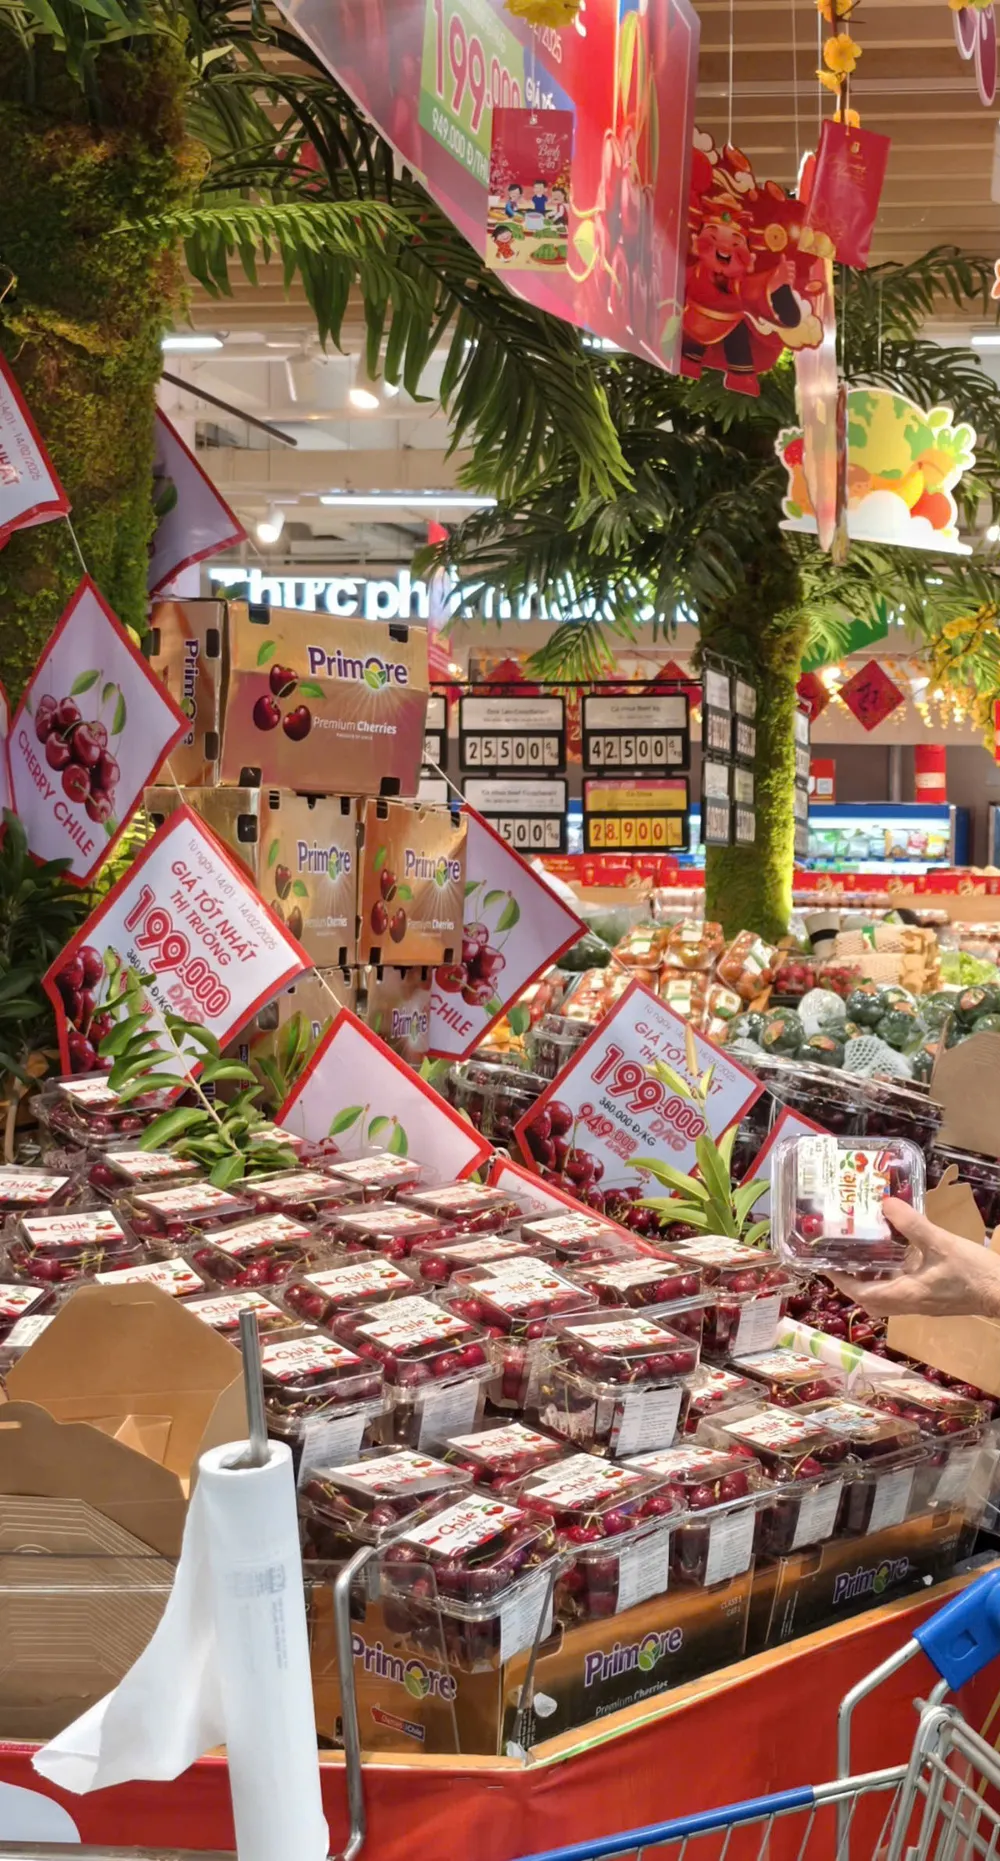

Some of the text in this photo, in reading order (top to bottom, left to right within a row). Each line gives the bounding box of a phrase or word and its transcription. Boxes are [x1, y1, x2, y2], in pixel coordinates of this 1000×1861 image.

[313, 716, 398, 735] Premium Cherries
[468, 739, 541, 760] 25.500
[592, 739, 664, 760] 42.500
[18, 730, 57, 802] CHERRY
[54, 801, 96, 858] CHILE
[502, 822, 542, 841] 500
[592, 823, 663, 840] 28.900
[171, 860, 257, 965] GIÁ TỐT NHẤT
[194, 852, 215, 877] ngày
[214, 872, 236, 899] 14/01
[238, 902, 277, 952] 14/02/2025
[170, 889, 232, 967] THỊ TRƯỜNG
[123, 883, 231, 1018] 199.000
[430, 994, 474, 1038] CHILE
[634, 1021, 687, 1070] GIÁ TỐT
[591, 1043, 707, 1142] 199.000
[576, 1101, 639, 1155] 949.000
[599, 1096, 657, 1147] 380.000 Đ/KG
[648, 1119, 688, 1152] Đ/KG
[839, 1171, 857, 1217] Chile
[48, 1219, 90, 1232] Chile
[335, 1271, 373, 1285] Chile
[200, 1301, 241, 1315] Chile
[388, 1319, 426, 1335] Chile
[275, 1346, 315, 1362] Chile
[481, 1434, 517, 1448] Chile
[365, 1461, 405, 1477] Chile
[560, 1474, 597, 1493] Chile
[438, 1511, 476, 1535] Chile
[634, 1679, 669, 1704] Cherries
